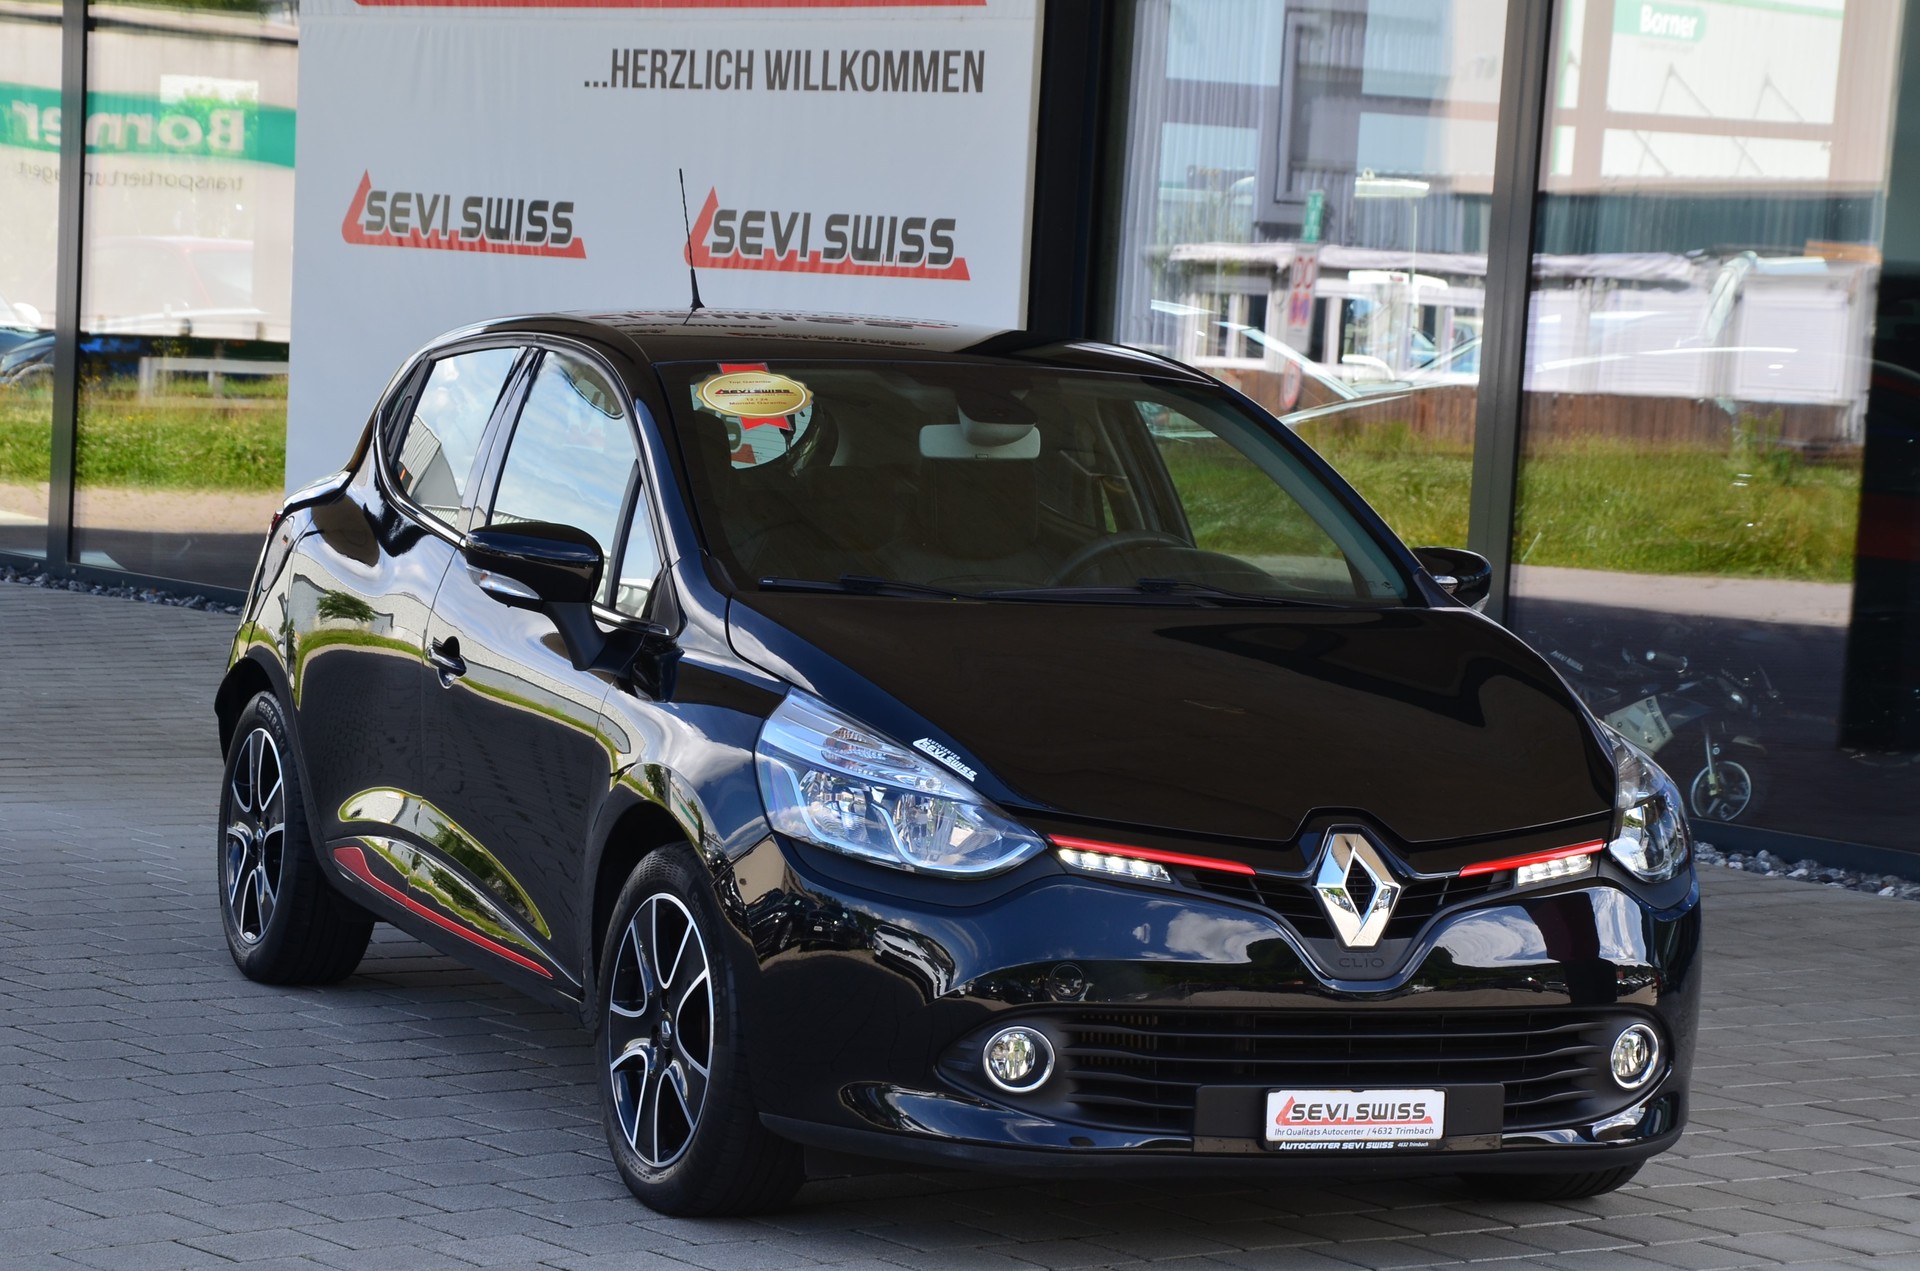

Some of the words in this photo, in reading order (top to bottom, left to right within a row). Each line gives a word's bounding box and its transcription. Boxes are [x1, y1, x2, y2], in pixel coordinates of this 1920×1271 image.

[1639, 4, 1698, 38] Borner
[764, 49, 985, 93] WILLKOMMEN
[365, 190, 451, 238] SEVI
[459, 195, 575, 246] SWISS
[710, 208, 812, 259] SEVI
[822, 213, 957, 267] SWISS
[920, 741, 947, 759] SEVI
[945, 756, 978, 778] SWISS
[1338, 957, 1385, 968] CLIO
[1290, 1103, 1349, 1121] SEVI
[1355, 1102, 1427, 1120] SWISS
[1274, 1128, 1286, 1136] Ihr
[1322, 1127, 1364, 1136] Autocenter
[1396, 1126, 1435, 1135] Trimbach
[1341, 1141, 1365, 1150] SEVI
[1366, 1141, 1395, 1149] SWISS
